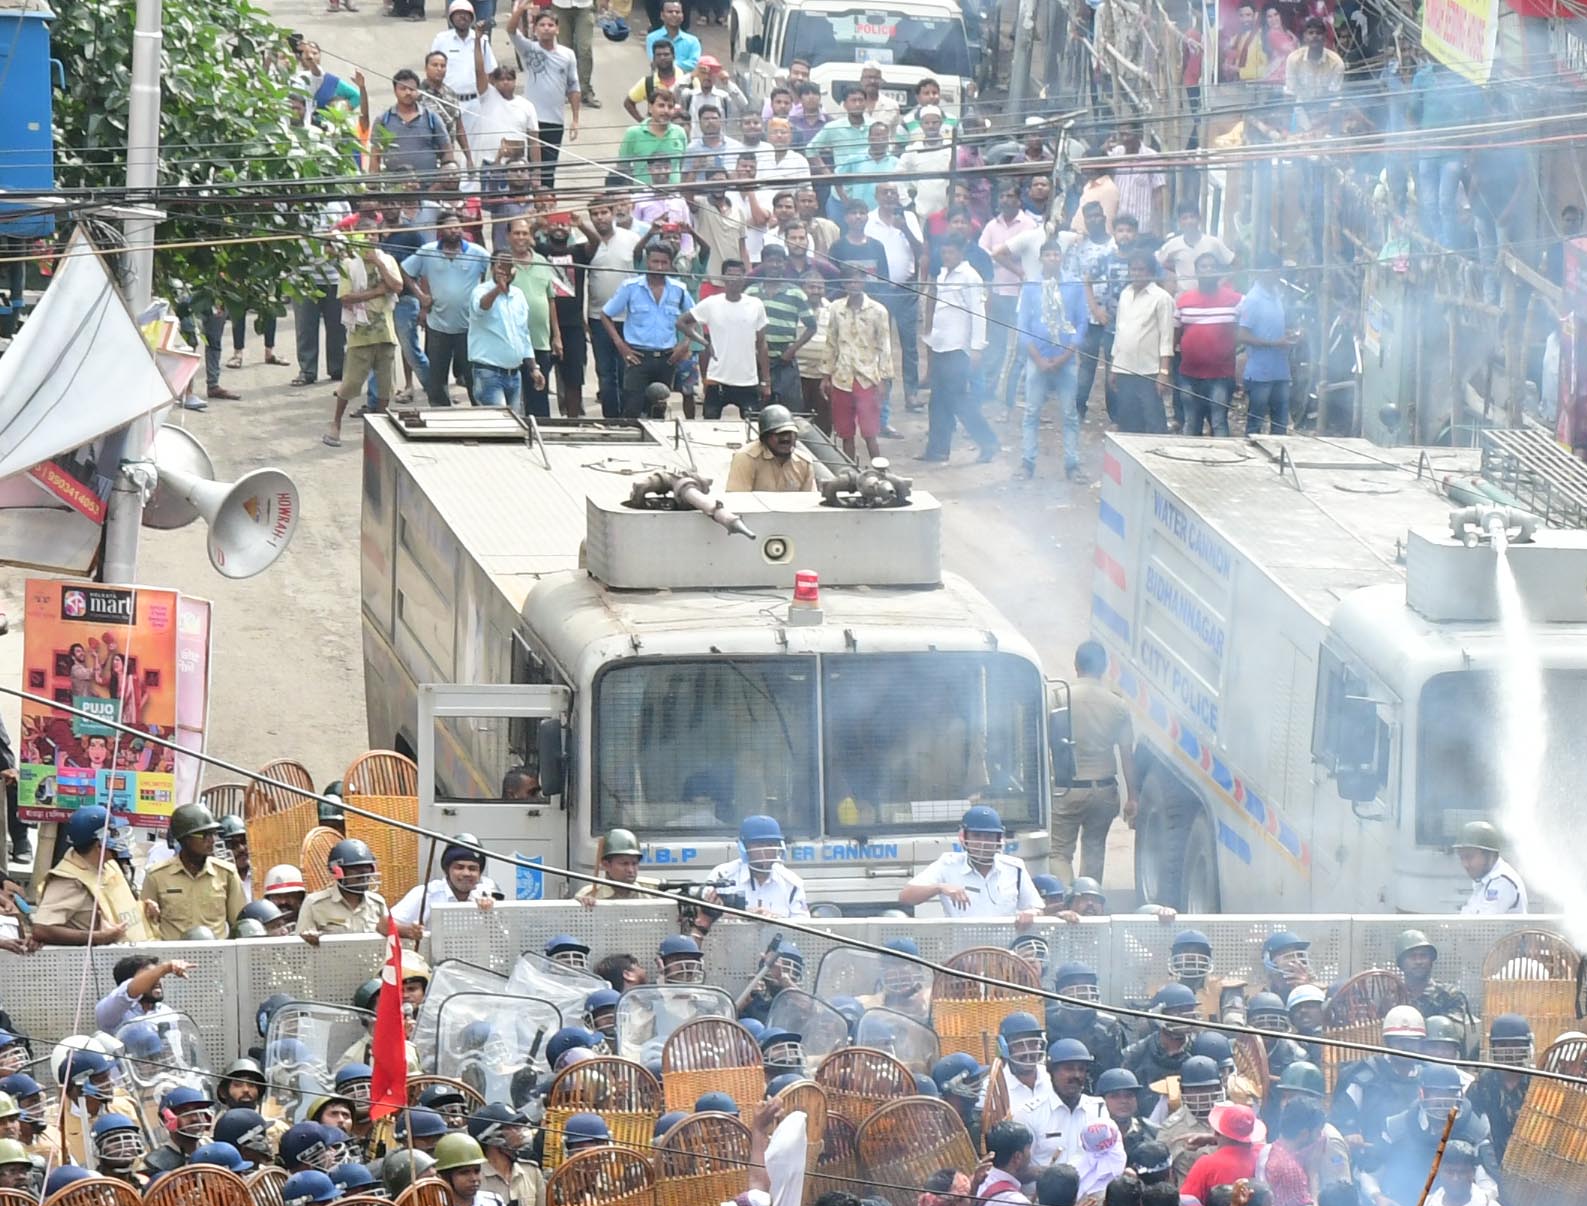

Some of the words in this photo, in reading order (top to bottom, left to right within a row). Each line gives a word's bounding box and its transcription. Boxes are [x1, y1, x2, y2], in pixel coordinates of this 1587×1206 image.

[1154, 488, 1188, 543] WATER
[1188, 523, 1231, 578] CANNON
[1145, 567, 1225, 659] BIDHANNAGAR
[1172, 670, 1218, 732] POLICE
[822, 844, 898, 861] CANNON
